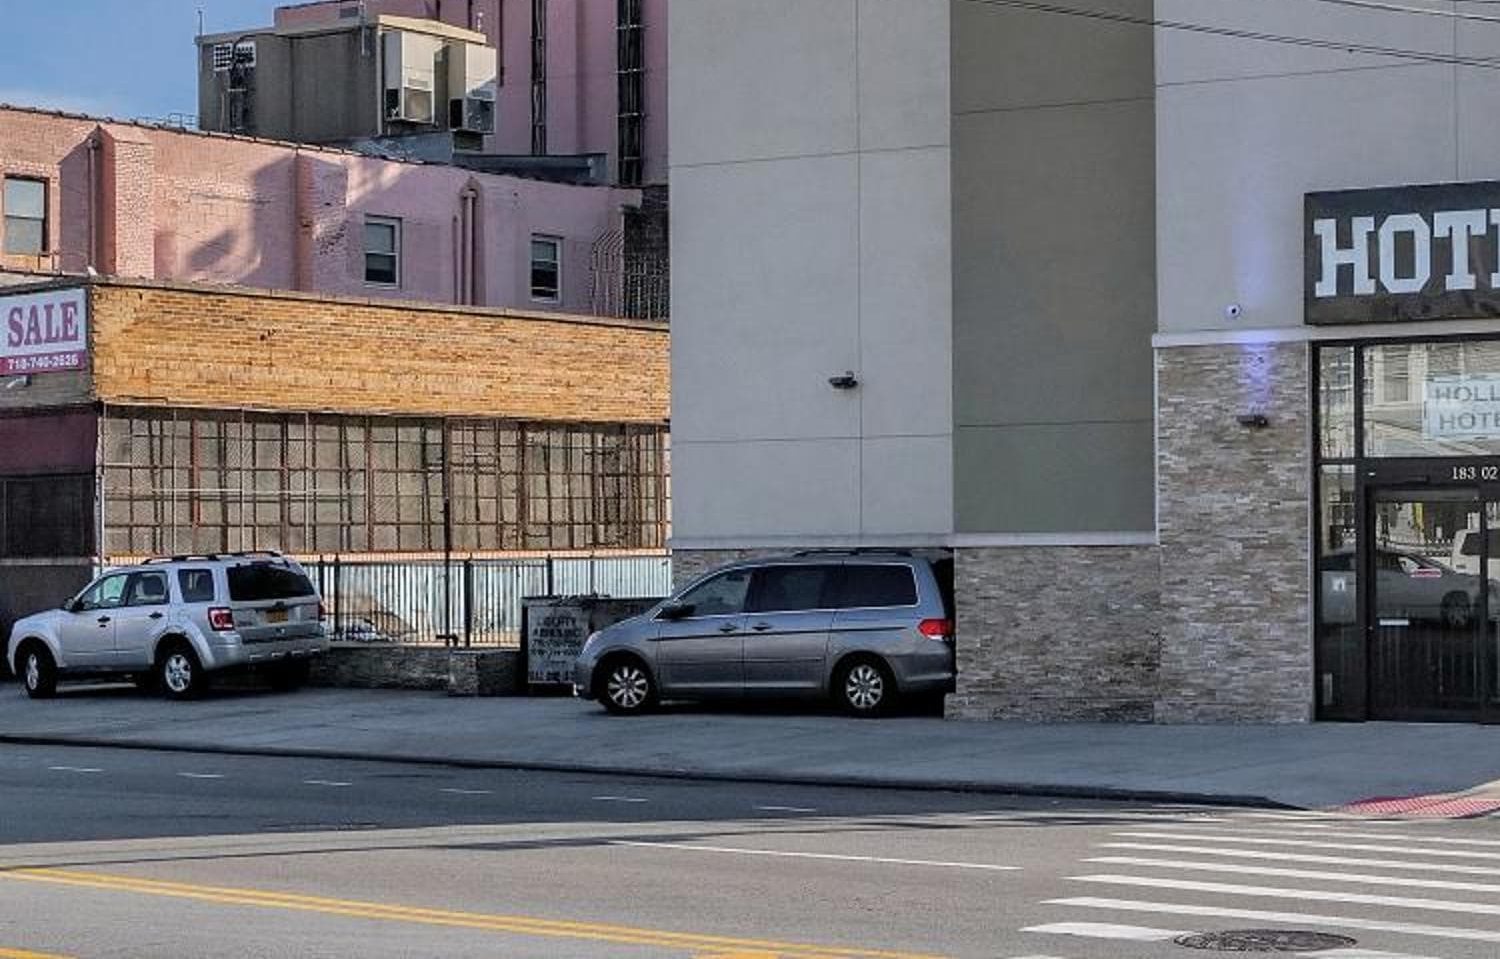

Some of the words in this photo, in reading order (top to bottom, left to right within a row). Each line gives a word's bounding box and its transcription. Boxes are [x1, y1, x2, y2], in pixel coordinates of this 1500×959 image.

[8, 301, 78, 347] SALE
[1453, 466, 1476, 480] 183
[1481, 466, 1499, 480] 02
